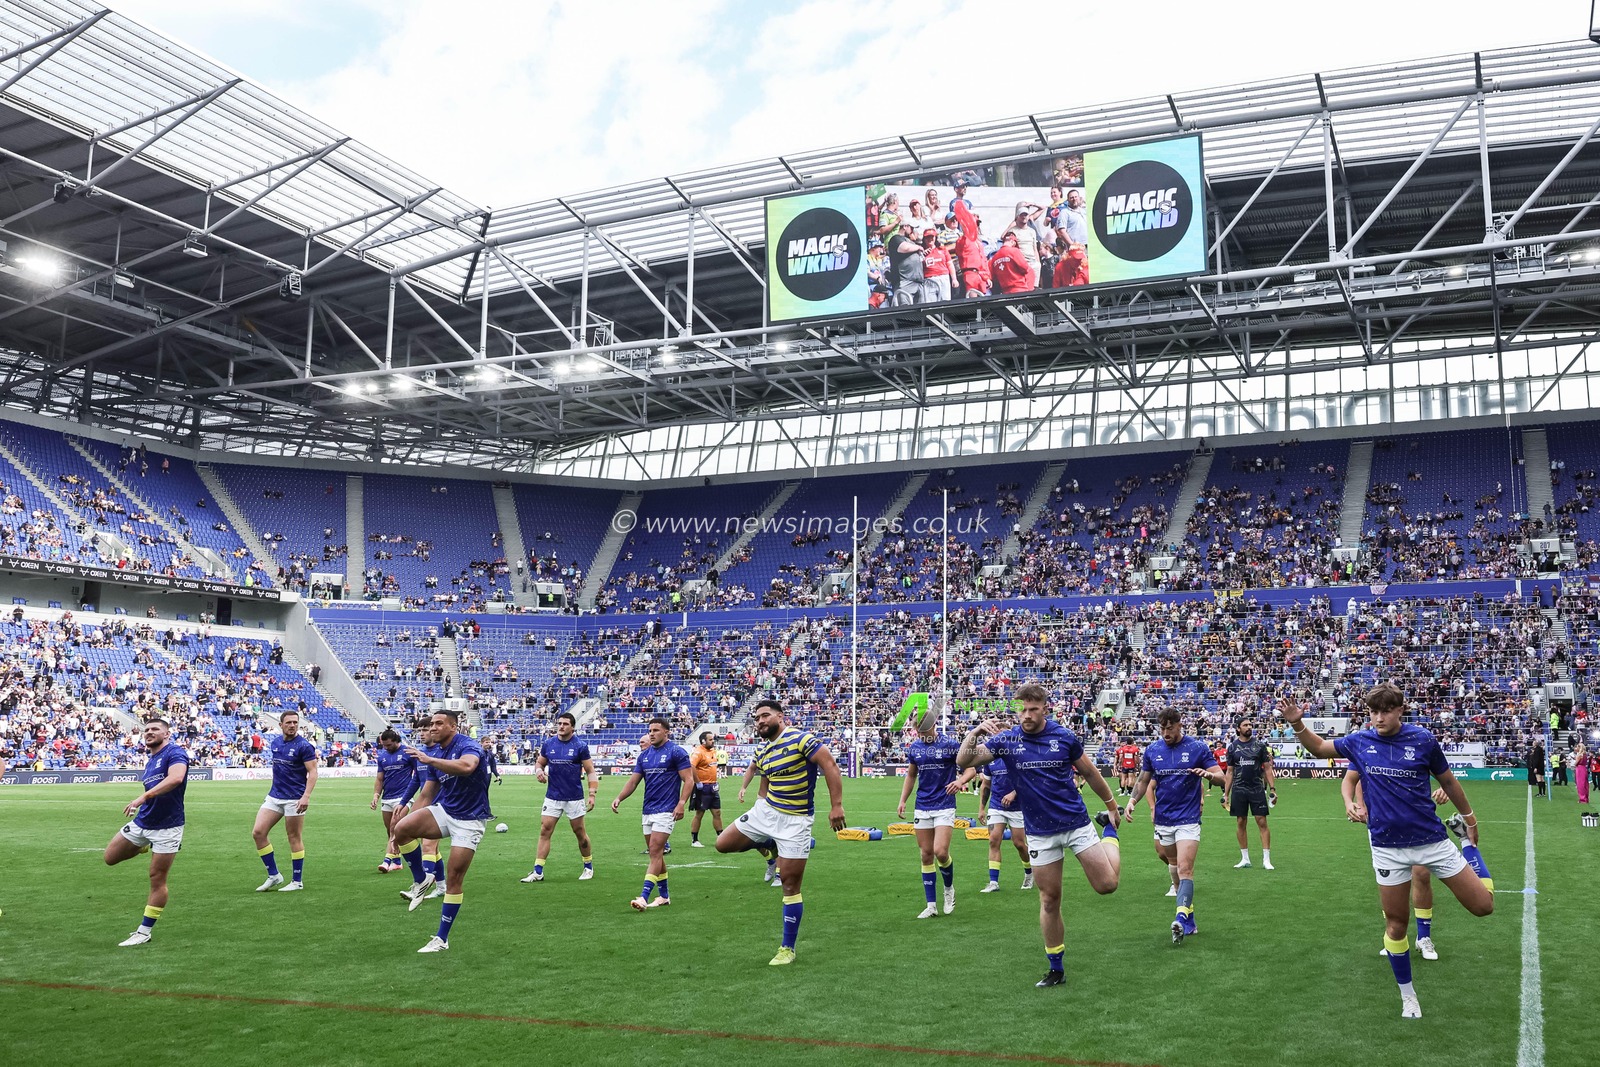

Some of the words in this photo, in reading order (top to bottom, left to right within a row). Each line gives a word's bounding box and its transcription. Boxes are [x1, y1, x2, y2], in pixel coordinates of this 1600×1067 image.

[1106, 187, 1178, 215] MAGIC
[1106, 208, 1178, 235] WKND
[788, 233, 849, 258] MAGIC
[788, 252, 849, 276] WKND
[21, 561, 39, 569] OXEN
[56, 565, 74, 574] OXEN
[90, 570, 107, 578] OXEN
[1554, 686, 1566, 694] 004
[1313, 722, 1325, 730] 005
[1022, 761, 1063, 769] ASHBROOK
[1275, 769, 1301, 778] WOLF
[1317, 769, 1342, 778] WOLF
[1370, 766, 1418, 778] ASHBROOK
[32, 776, 58, 784] BOOST
